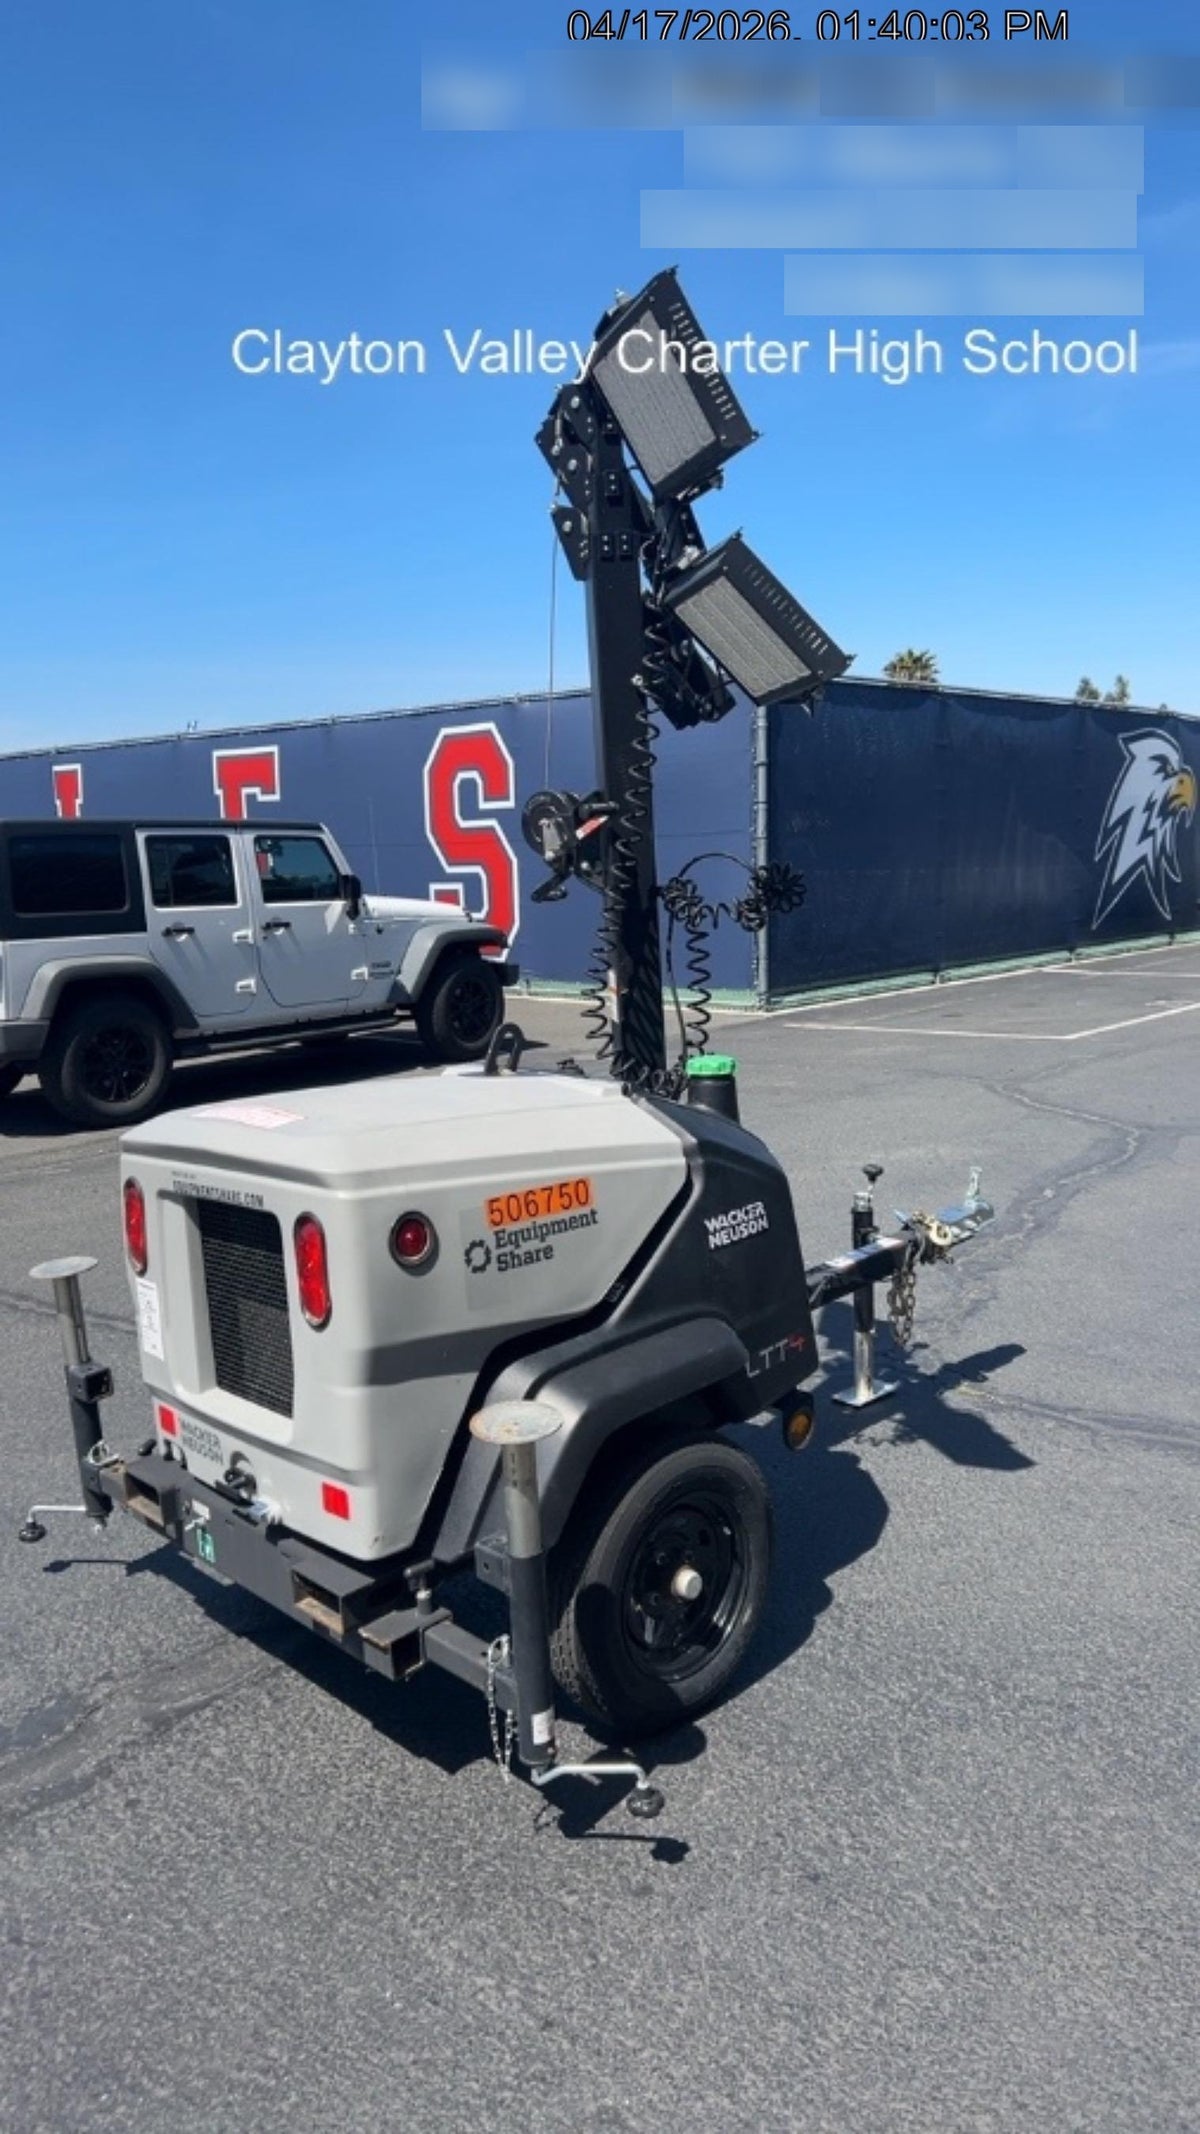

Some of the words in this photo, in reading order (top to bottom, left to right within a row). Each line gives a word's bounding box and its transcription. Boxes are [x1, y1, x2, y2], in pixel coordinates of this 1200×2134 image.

[487, 1178, 590, 1227] 506750
[704, 1201, 767, 1233] WACKER
[492, 1209, 599, 1250] Equipment
[708, 1214, 770, 1250] NEUSON
[495, 1244, 554, 1272] Share
